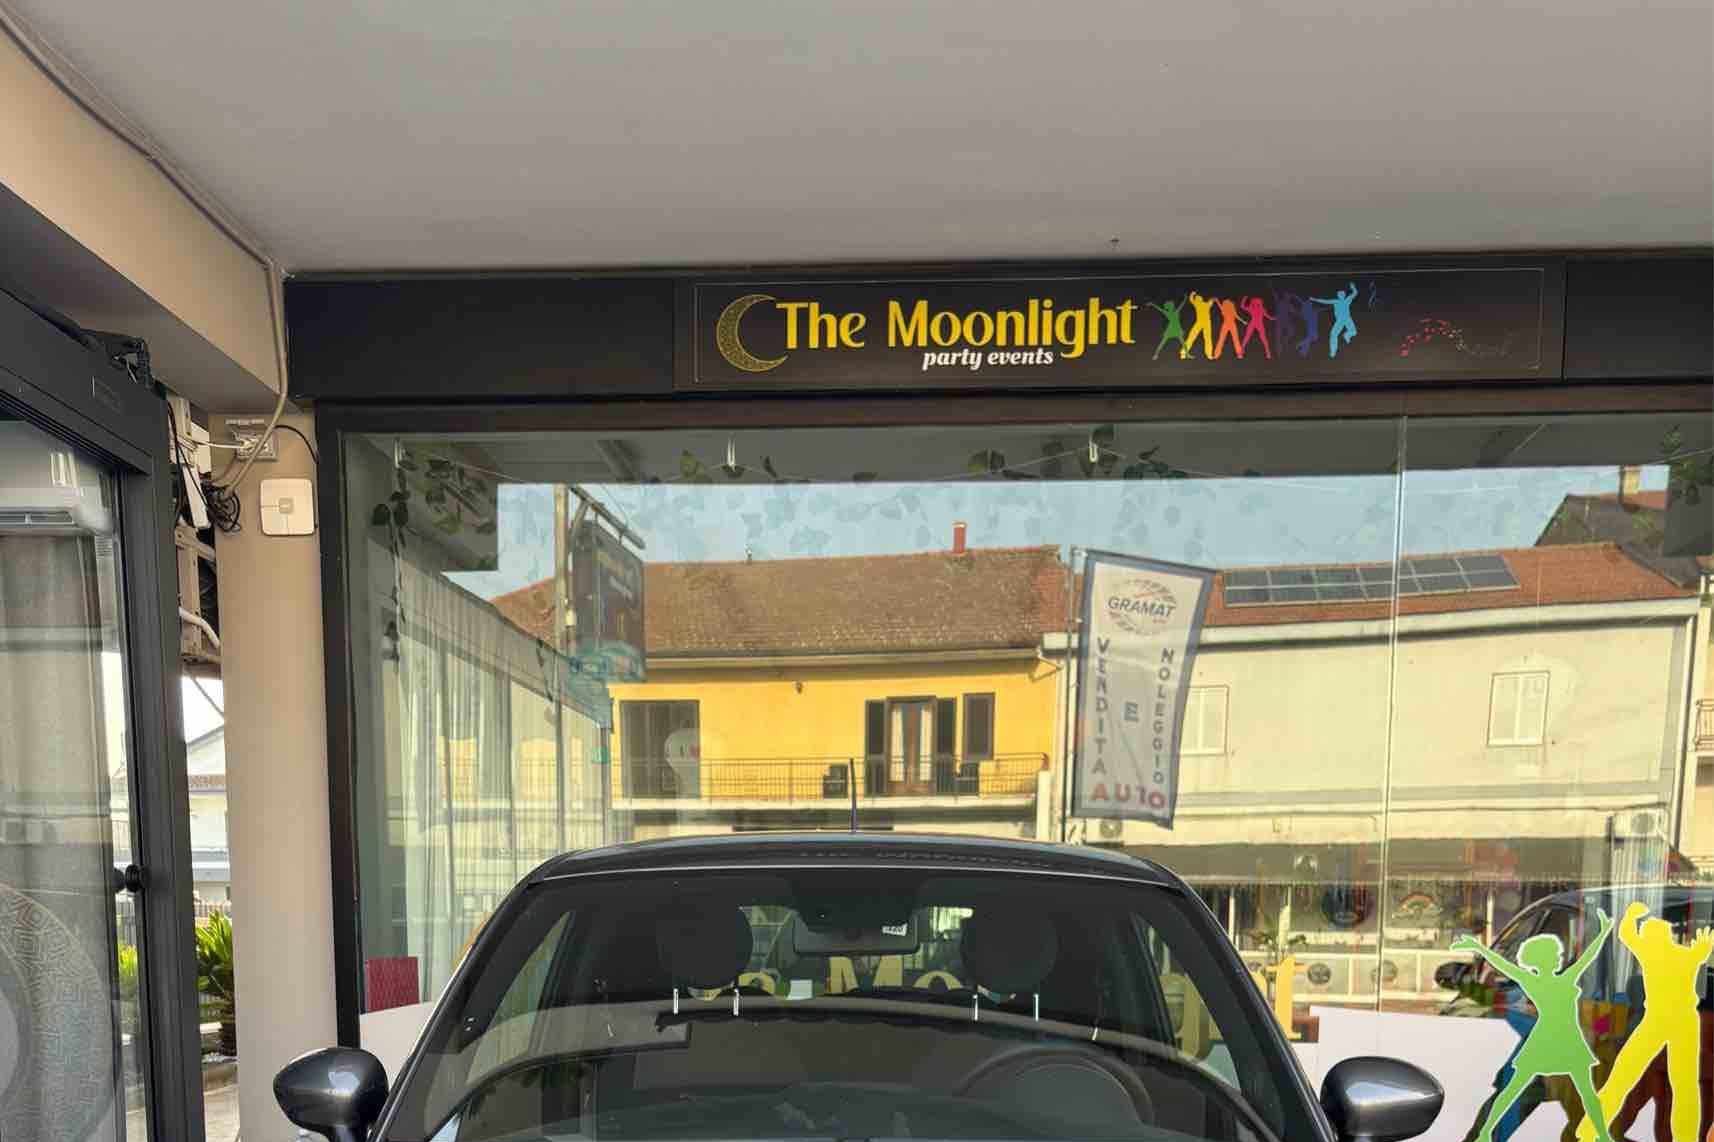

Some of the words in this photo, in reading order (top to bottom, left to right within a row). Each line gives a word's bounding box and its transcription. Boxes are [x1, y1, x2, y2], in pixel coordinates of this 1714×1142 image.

[775, 301, 866, 349] The
[888, 298, 1136, 359] Moonlight
[922, 348, 982, 370] party
[987, 346, 1054, 367] events
[1108, 597, 1176, 617] GRAMAT
[1091, 637, 1110, 774] VENDITA
[1152, 647, 1174, 785] NOLEGGIO
